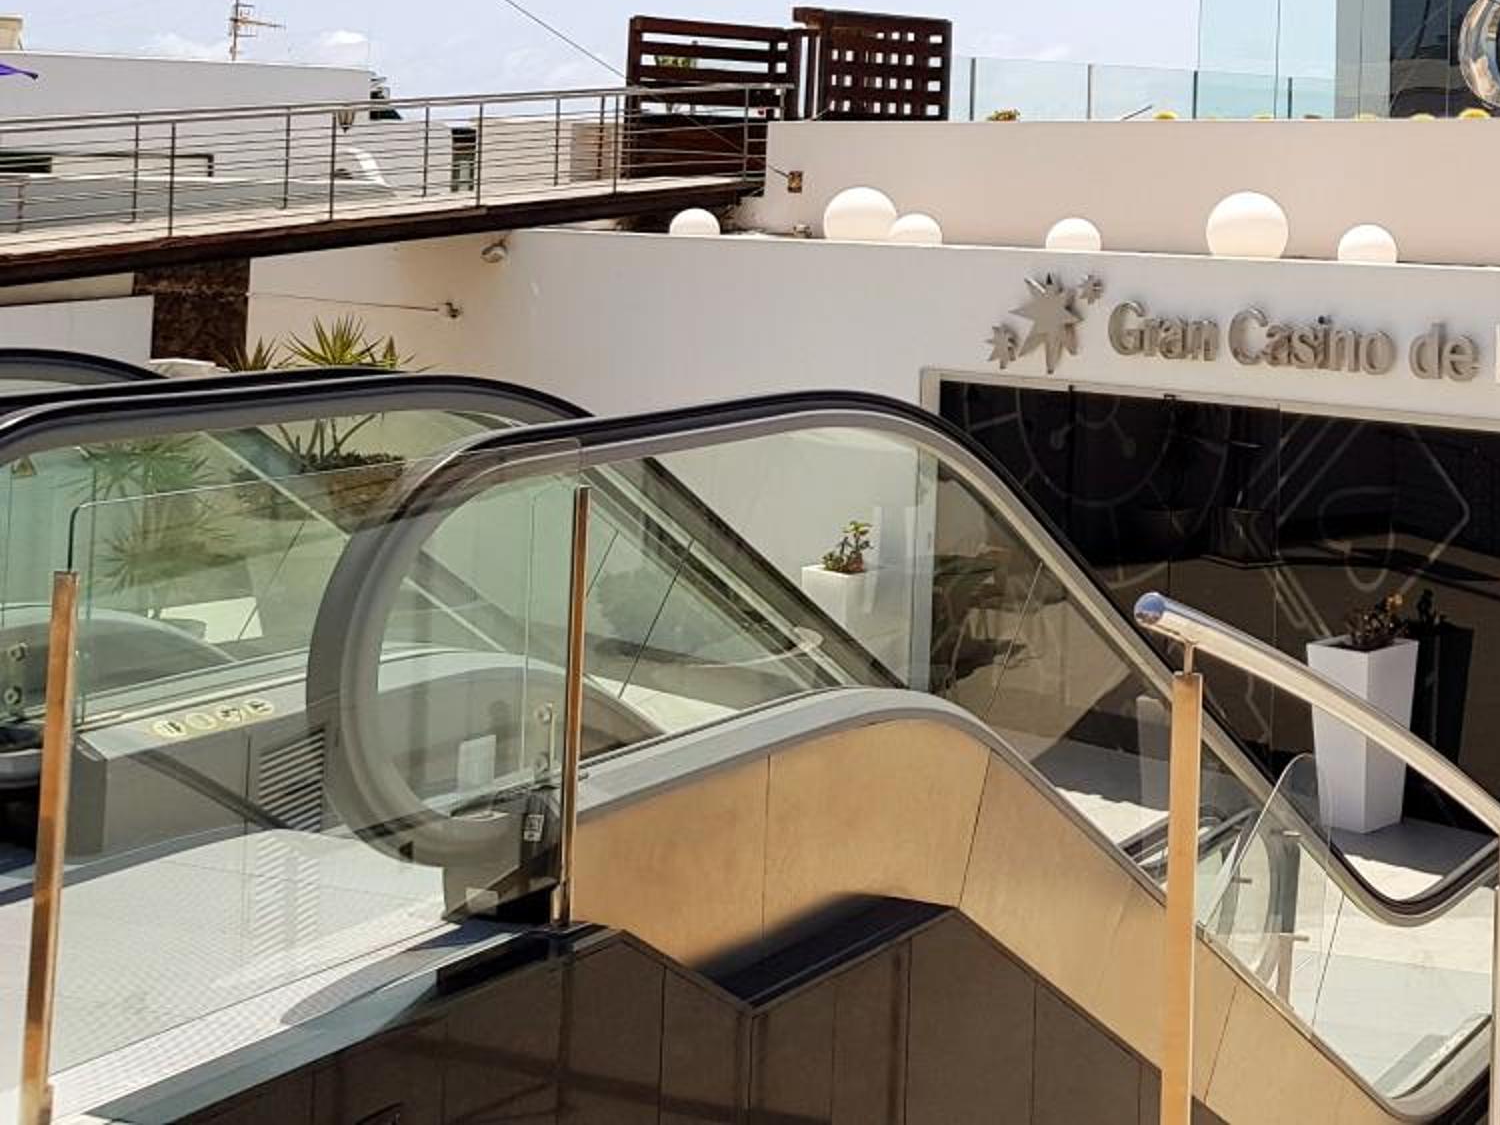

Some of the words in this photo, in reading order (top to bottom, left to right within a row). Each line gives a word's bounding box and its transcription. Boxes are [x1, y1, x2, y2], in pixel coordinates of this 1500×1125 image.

[1107, 300, 1220, 361] Gran
[1228, 307, 1397, 376] Casino
[1408, 322, 1480, 382] de
